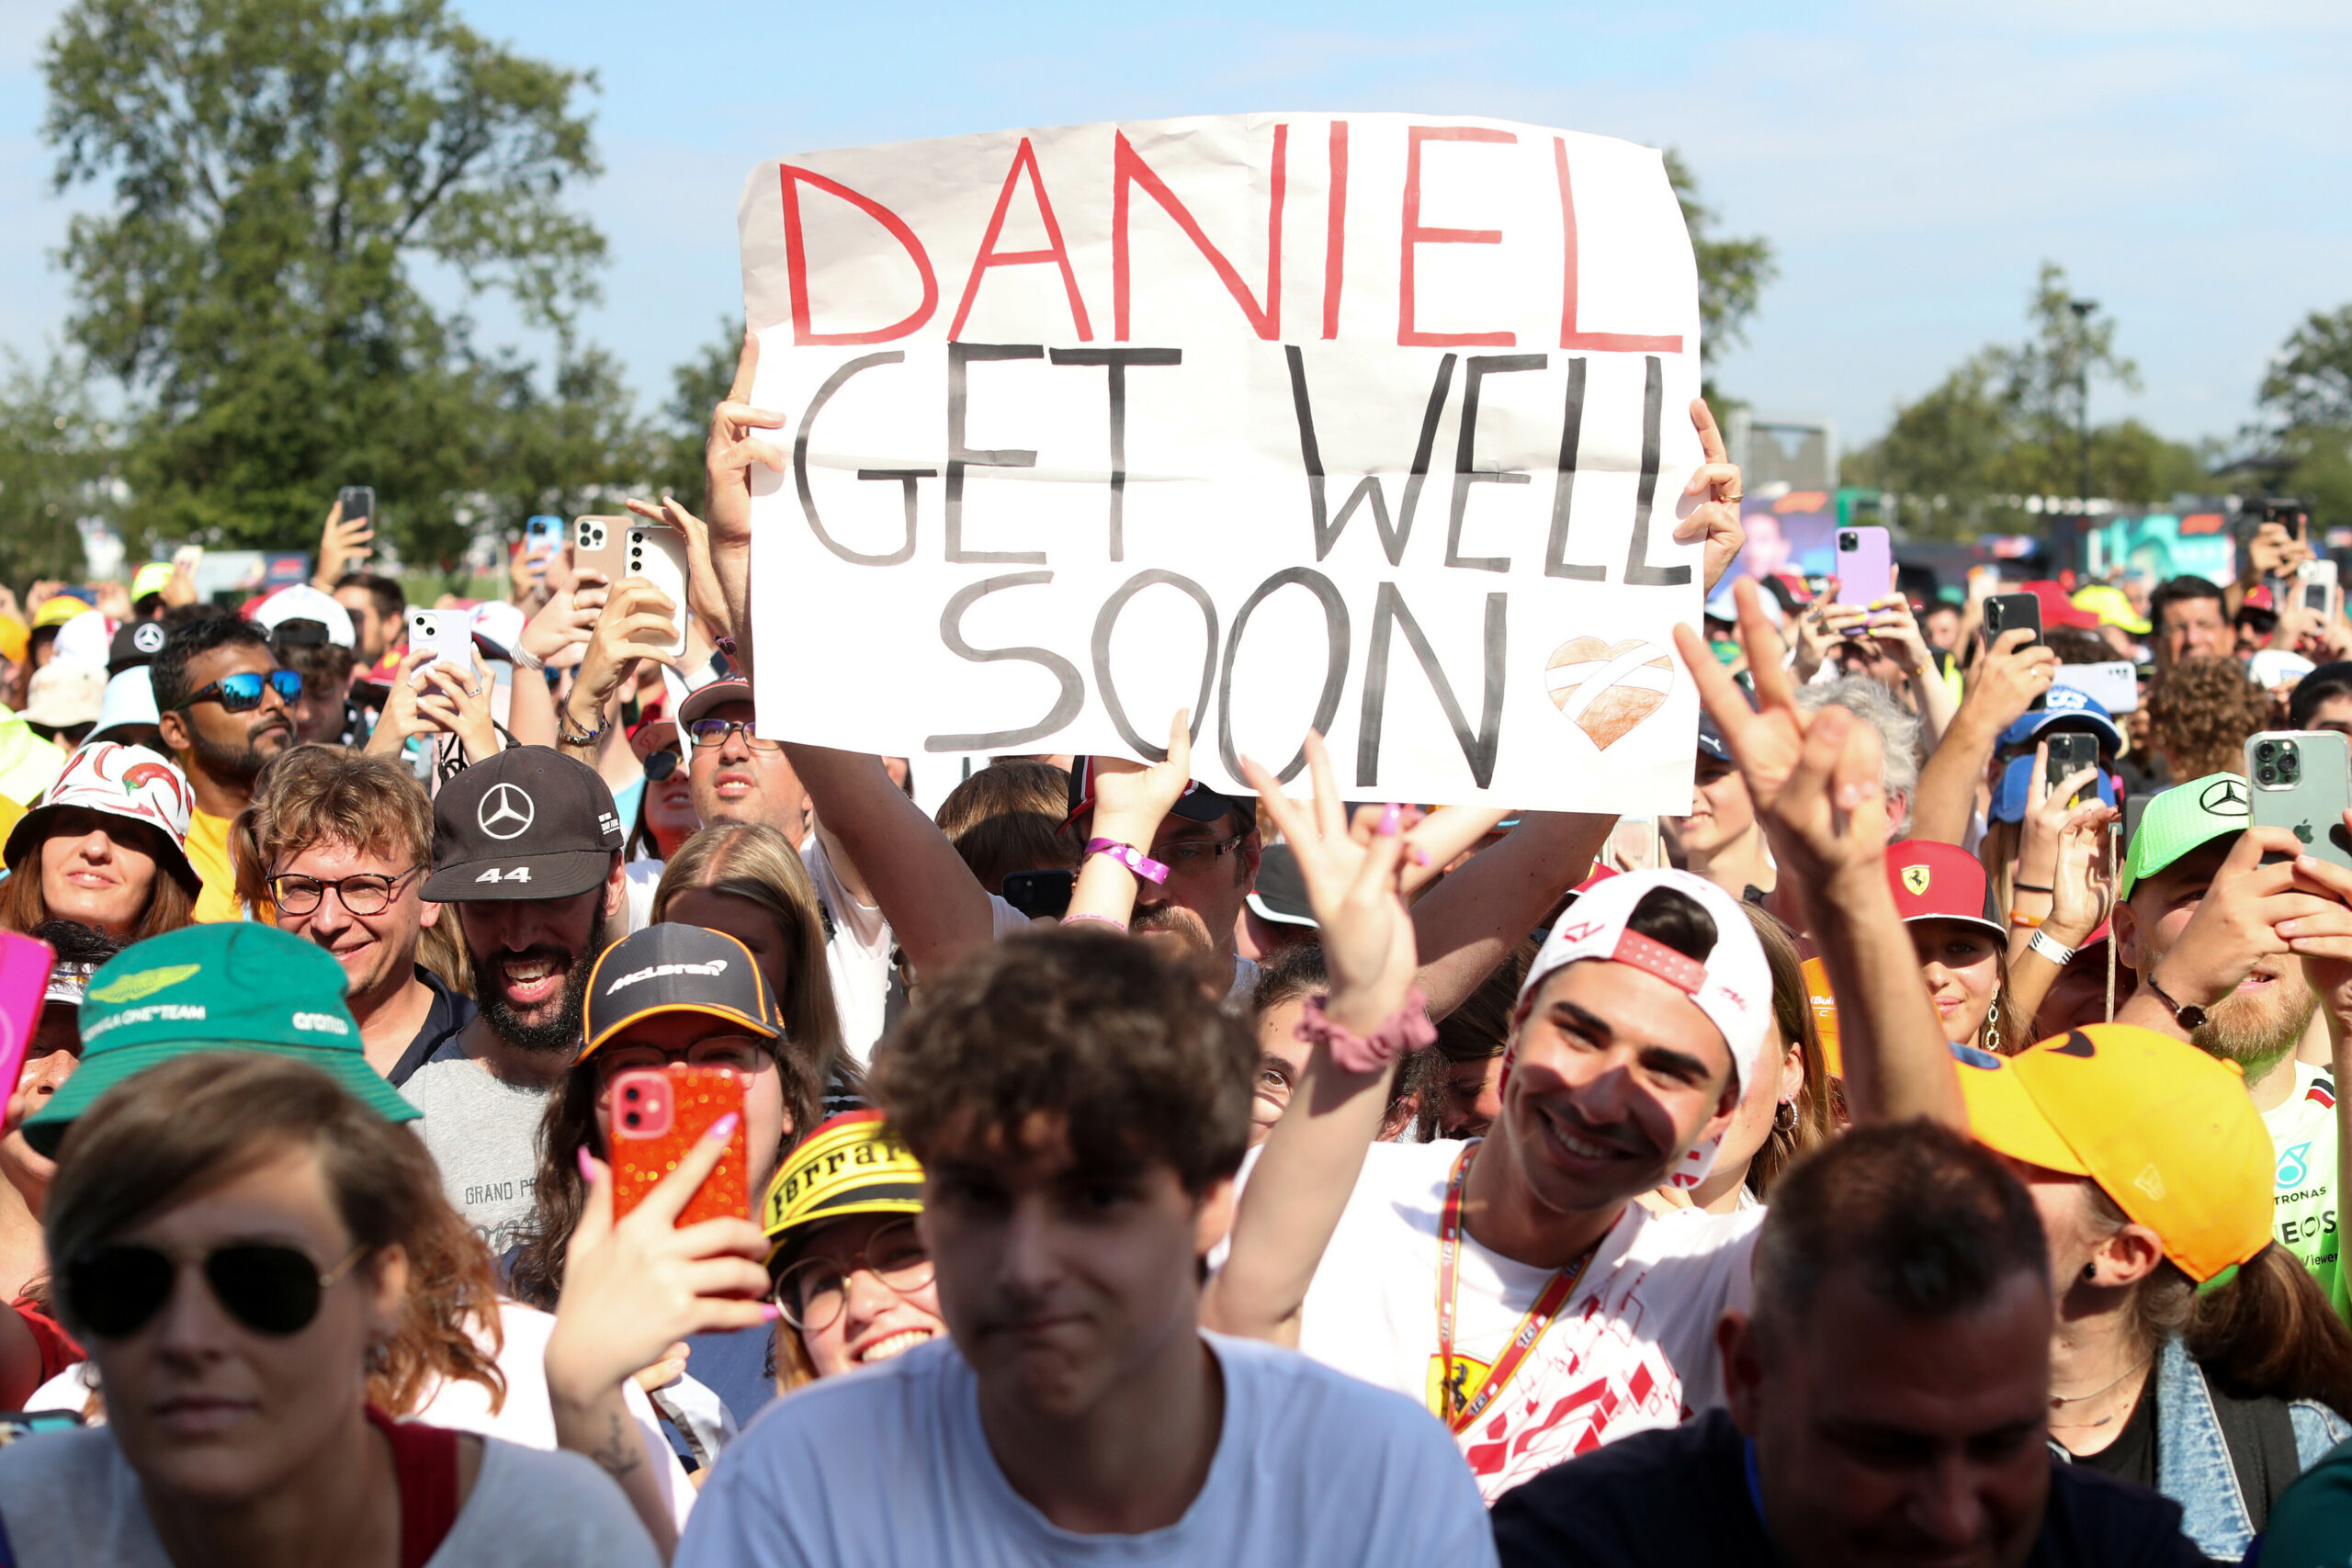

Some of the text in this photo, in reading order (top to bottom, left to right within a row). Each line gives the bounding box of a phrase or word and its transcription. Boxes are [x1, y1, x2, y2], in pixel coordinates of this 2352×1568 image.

[779, 120, 1683, 353] DANIEL
[794, 342, 1692, 585] GET WELL
[924, 566, 1509, 788] SOON
[475, 866, 532, 884] 44
[466, 1182, 513, 1205] GRAND
[2274, 1187, 2326, 1205] TRONAS
[2281, 1211, 2336, 1245] EOS
